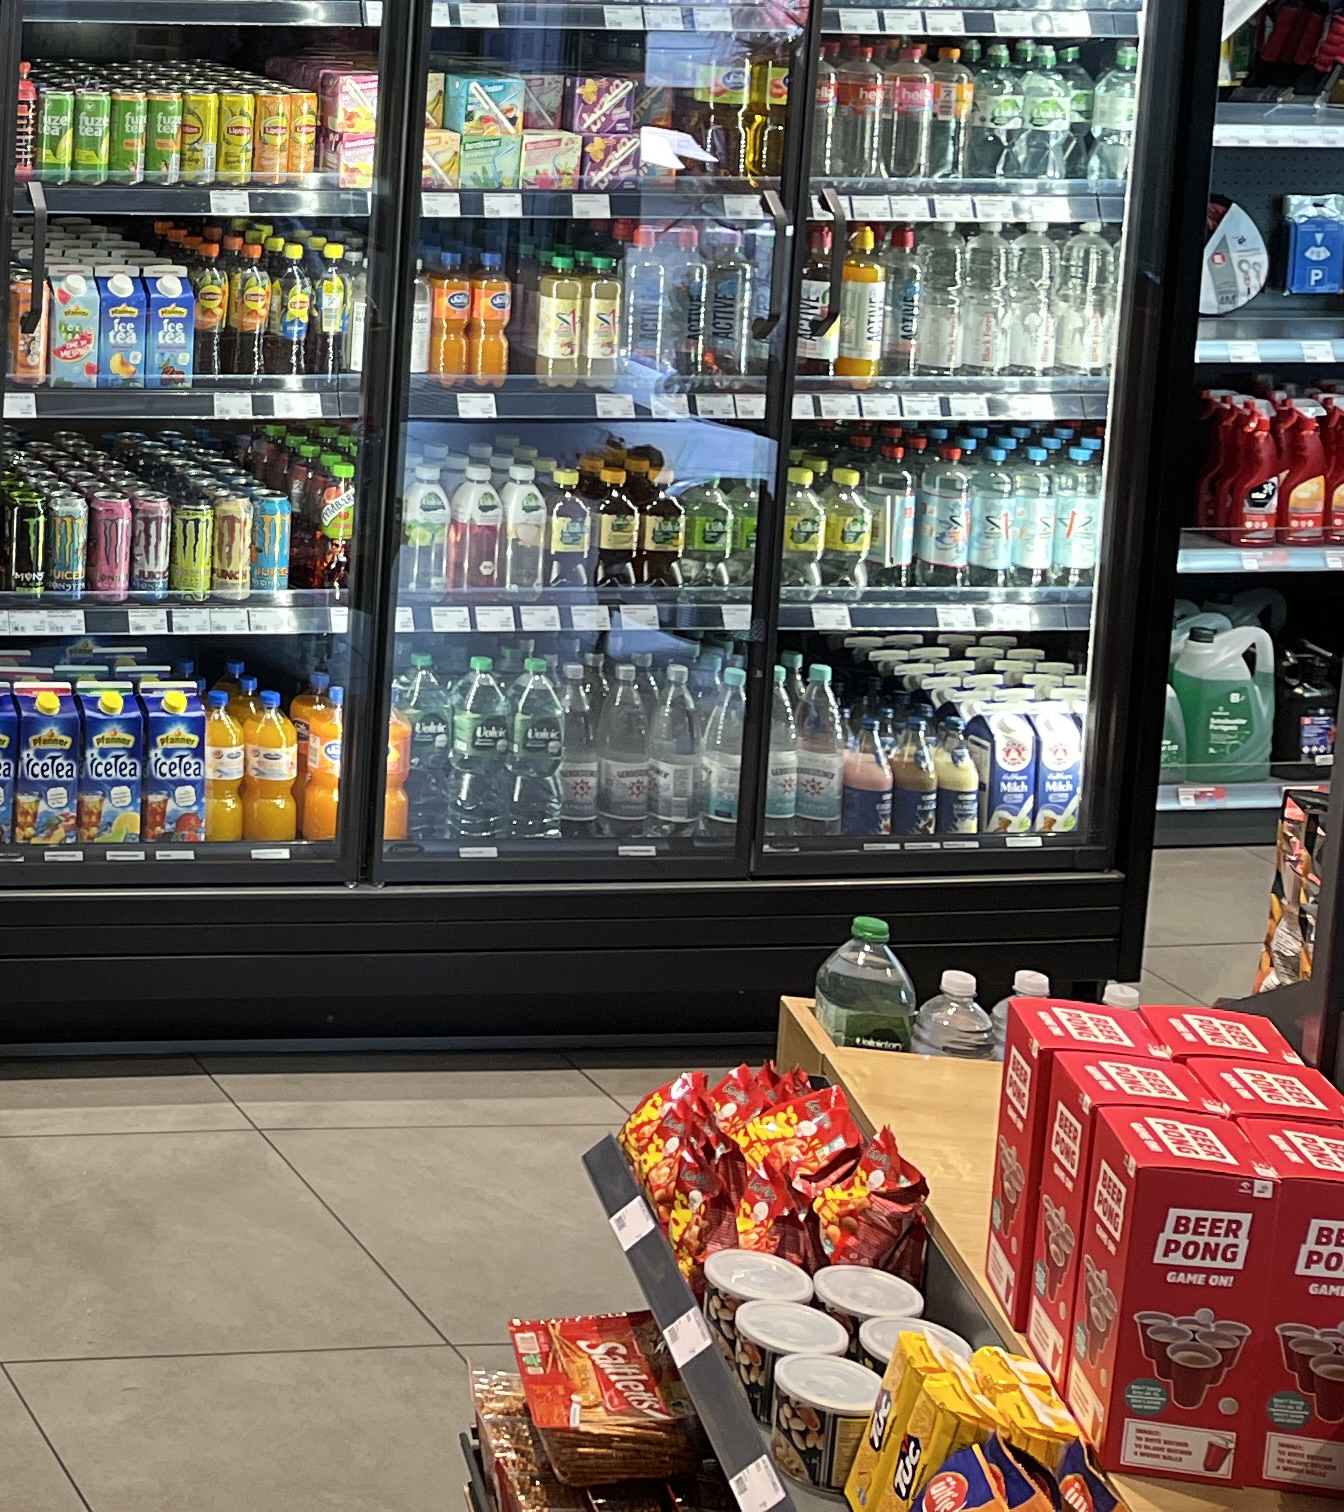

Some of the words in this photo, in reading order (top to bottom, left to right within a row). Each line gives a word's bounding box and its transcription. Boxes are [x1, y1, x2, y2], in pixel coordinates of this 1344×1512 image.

[79, 124, 103, 137] tea
[1309, 268, 1324, 286] P
[713, 287, 736, 342] ACTIVE
[108, 331, 137, 345] tea
[156, 331, 186, 345] tea
[33, 735, 71, 750] pfanner
[95, 735, 134, 750] pfanner
[159, 735, 198, 750] pfanner
[999, 779, 1029, 793] Milch
[1043, 778, 1074, 793] Milch
[1065, 1013, 1094, 1040] PONG
[1196, 1019, 1233, 1046] PONG
[1111, 1065, 1152, 1096] PONG
[1246, 1073, 1288, 1104] PONG
[1160, 1121, 1198, 1158] PONG
[1172, 1214, 1243, 1240] BEER
[1162, 1239, 1240, 1264] PONG
[1166, 1270, 1206, 1286] GAME
[1208, 1274, 1235, 1288] ON!
[576, 1338, 672, 1421] Saltletts
[869, 1399, 891, 1450] TUC
[894, 1438, 923, 1498] TUC
